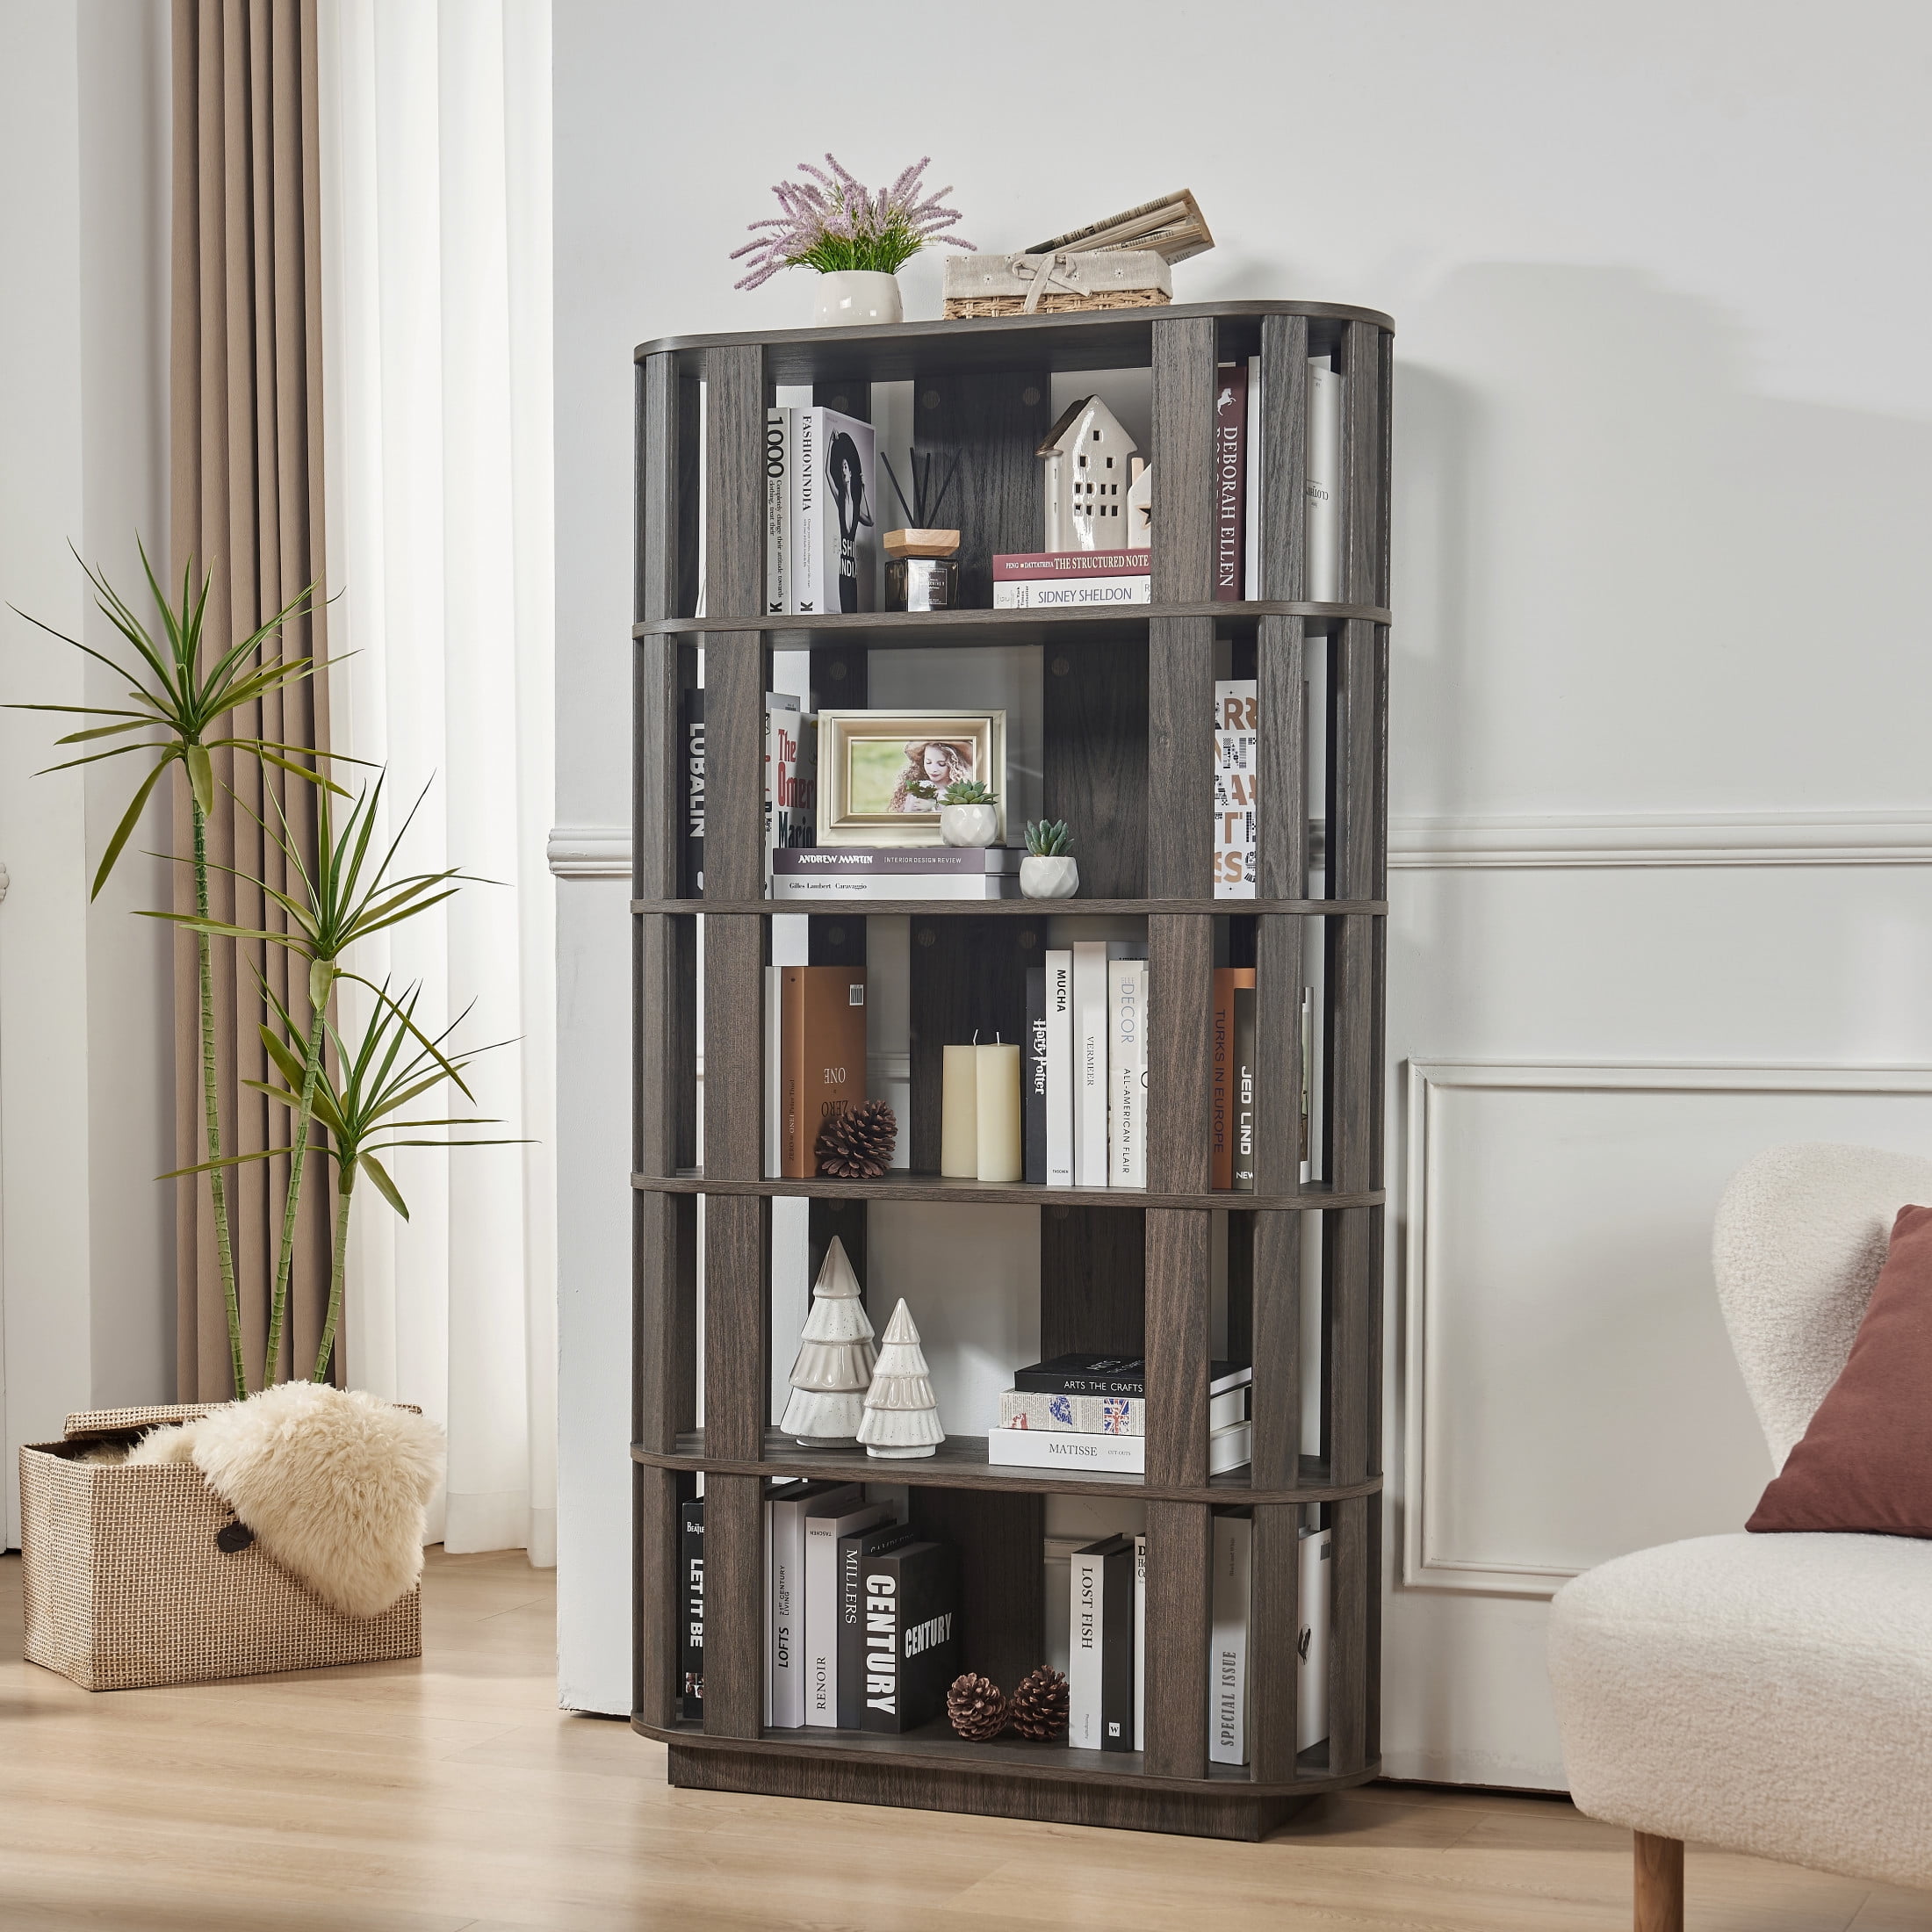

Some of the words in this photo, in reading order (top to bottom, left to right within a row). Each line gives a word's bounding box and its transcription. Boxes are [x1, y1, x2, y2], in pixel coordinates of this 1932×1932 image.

[768, 416, 784, 479] 1000
[802, 415, 812, 512] FASHIONINDIA
[1221, 425, 1238, 520] DEBORAH
[841, 538, 854, 558] SHI
[1054, 558, 1071, 570] THE
[1071, 555, 1125, 570] STRUCTURED
[1126, 554, 1149, 567] NOTE
[1219, 526, 1235, 588] ELLEN
[1038, 589, 1077, 603] SIDNEY
[1078, 587, 1132, 602] SHELDON
[778, 728, 797, 763] The
[689, 723, 705, 837] LUBALIN
[777, 761, 818, 809] Omer
[797, 854, 839, 864] ANDREW
[839, 854, 874, 864] MARTIN
[834, 882, 868, 890] Caravaggio
[1056, 969, 1066, 1013] MUCHA
[1120, 984, 1135, 1043] DECOR
[1033, 1018, 1046, 1057] Harry
[1215, 1009, 1226, 1062] TURKS
[824, 1067, 847, 1085] ONE
[1030, 1056, 1046, 1095] Potter
[1215, 1067, 1224, 1082] IN
[1241, 1065, 1252, 1104] JED
[820, 1099, 849, 1118] ZERO
[1122, 1068, 1131, 1143] ALL-AMERICAN
[1214, 1087, 1224, 1153] EUROPE
[1240, 1112, 1251, 1155] LIND
[1122, 1147, 1131, 1173] FLAIR
[1063, 1381, 1085, 1390] ARTS
[1089, 1381, 1107, 1391] THE
[1110, 1382, 1143, 1393] CRAFTS
[1049, 1444, 1098, 1457] MATISSE
[687, 1521, 705, 1535] BEATLE
[690, 1558, 703, 1595] LET
[845, 1549, 858, 1625] MILLERS
[1081, 1566, 1093, 1609] LOST
[690, 1598, 703, 1618] IT
[690, 1621, 703, 1647] BE
[778, 1626, 789, 1669] LOFTS
[866, 1574, 897, 1715] CENTURY
[905, 1612, 953, 1659] CENTURY
[1081, 1611, 1093, 1650] FISH
[816, 1656, 826, 1710] RENOIR
[1222, 1651, 1236, 1688] ISSUE
[1221, 1693, 1236, 1747] SPECIAL
